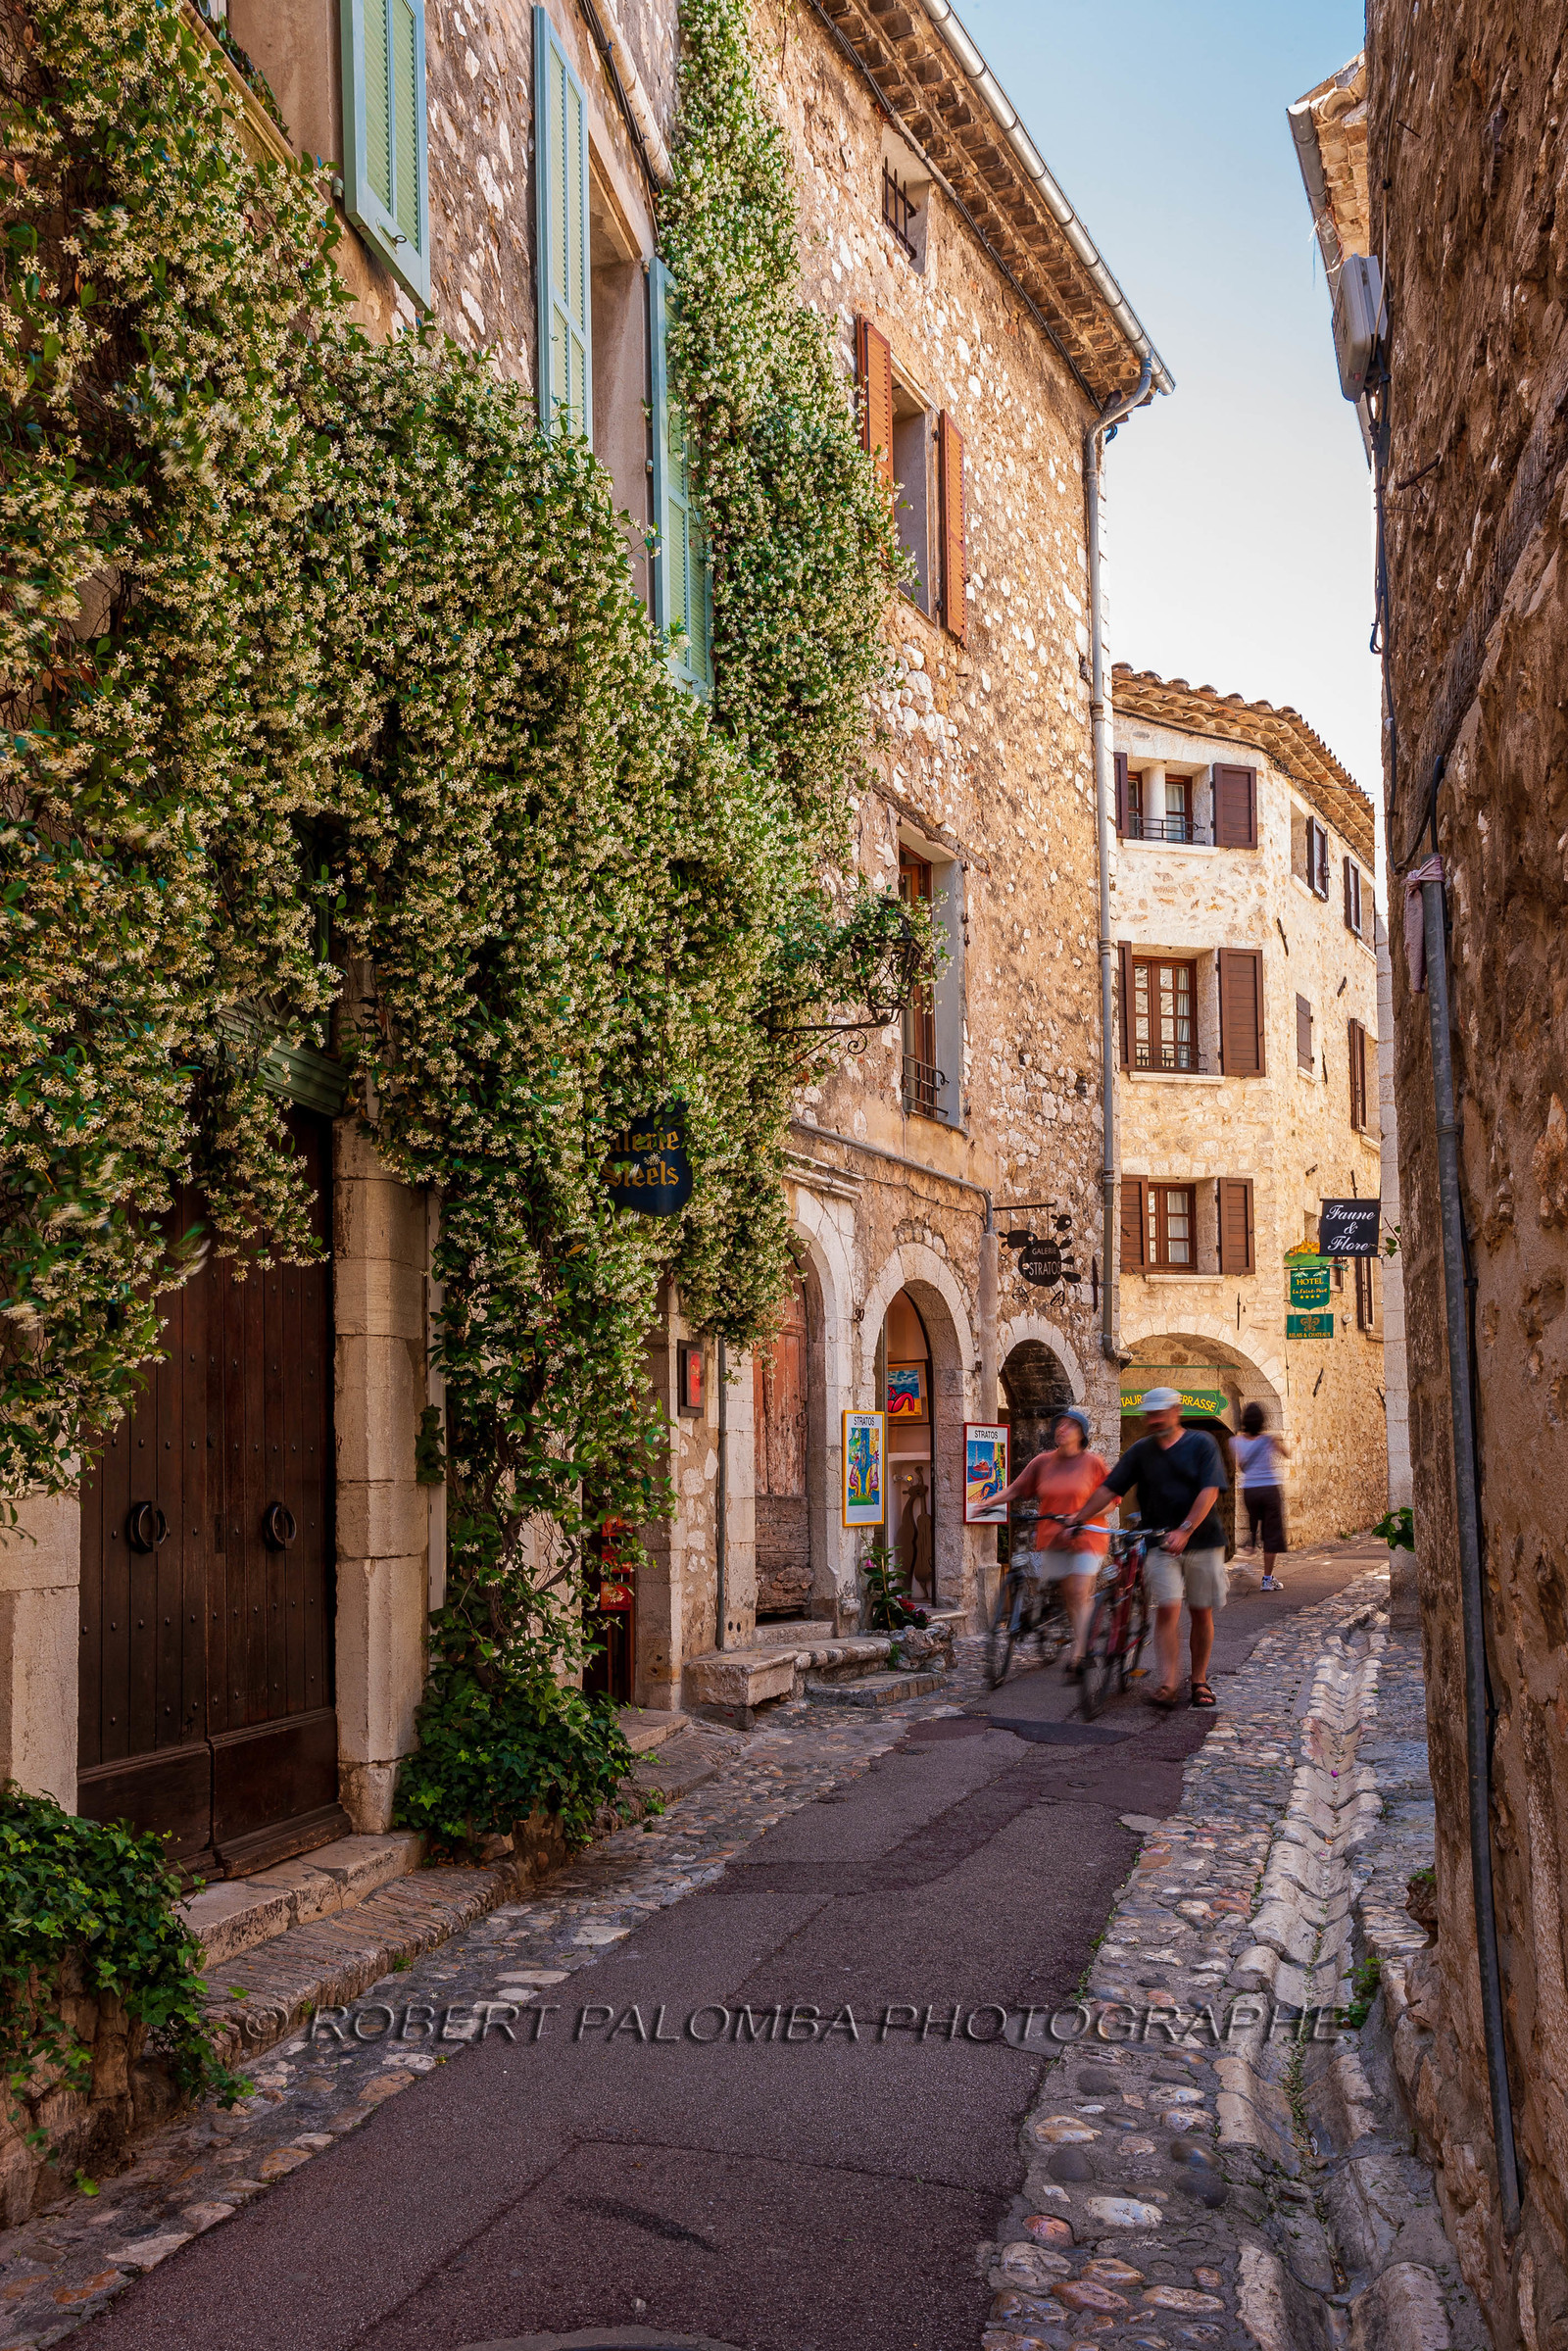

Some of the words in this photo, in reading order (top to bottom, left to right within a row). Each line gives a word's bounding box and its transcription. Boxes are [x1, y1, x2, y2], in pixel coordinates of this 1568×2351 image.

[607, 1126, 680, 1152] alerie
[1326, 1204, 1376, 1220] Faune
[1344, 1221, 1358, 1234] &
[1031, 1247, 1057, 1255] GALERIE
[1327, 1235, 1370, 1251] Flore
[1028, 1260, 1061, 1276] STRATOS
[1178, 1394, 1217, 1412] ERRASSE
[854, 1416, 875, 1426] STRATOS
[974, 1429, 999, 1440] STRATOS
